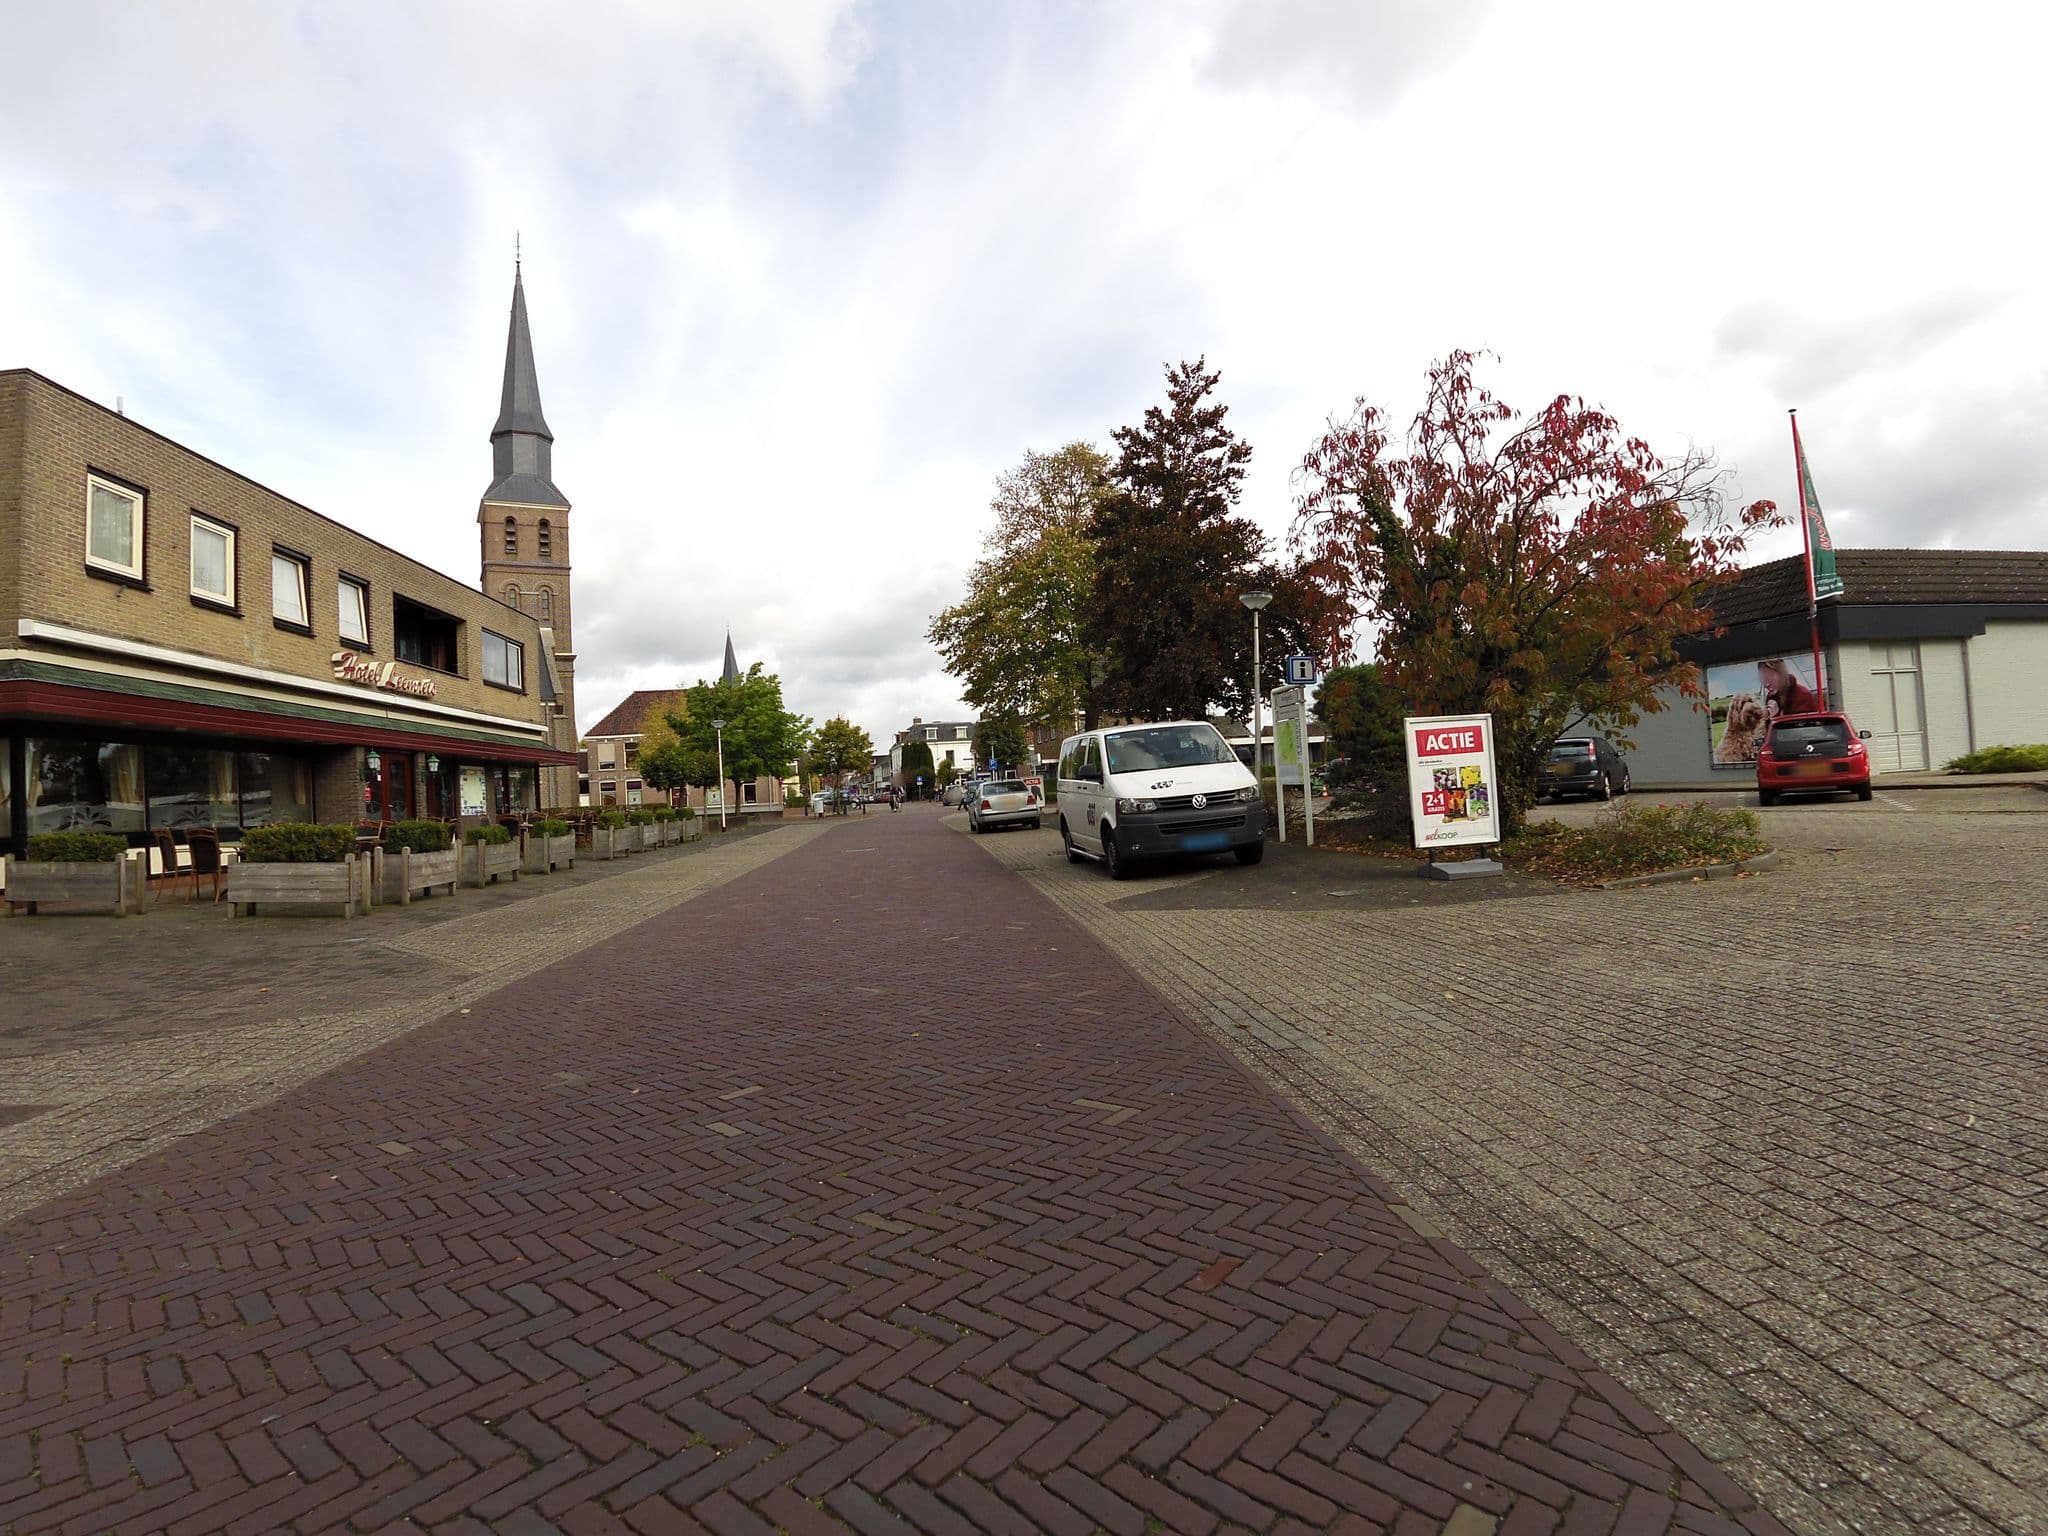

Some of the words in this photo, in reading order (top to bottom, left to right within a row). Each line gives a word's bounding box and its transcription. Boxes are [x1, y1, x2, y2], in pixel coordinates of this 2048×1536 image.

[331, 651, 380, 684] Hotel
[1426, 731, 1475, 751] ACTIE
[1426, 793, 1445, 806] 2+1
